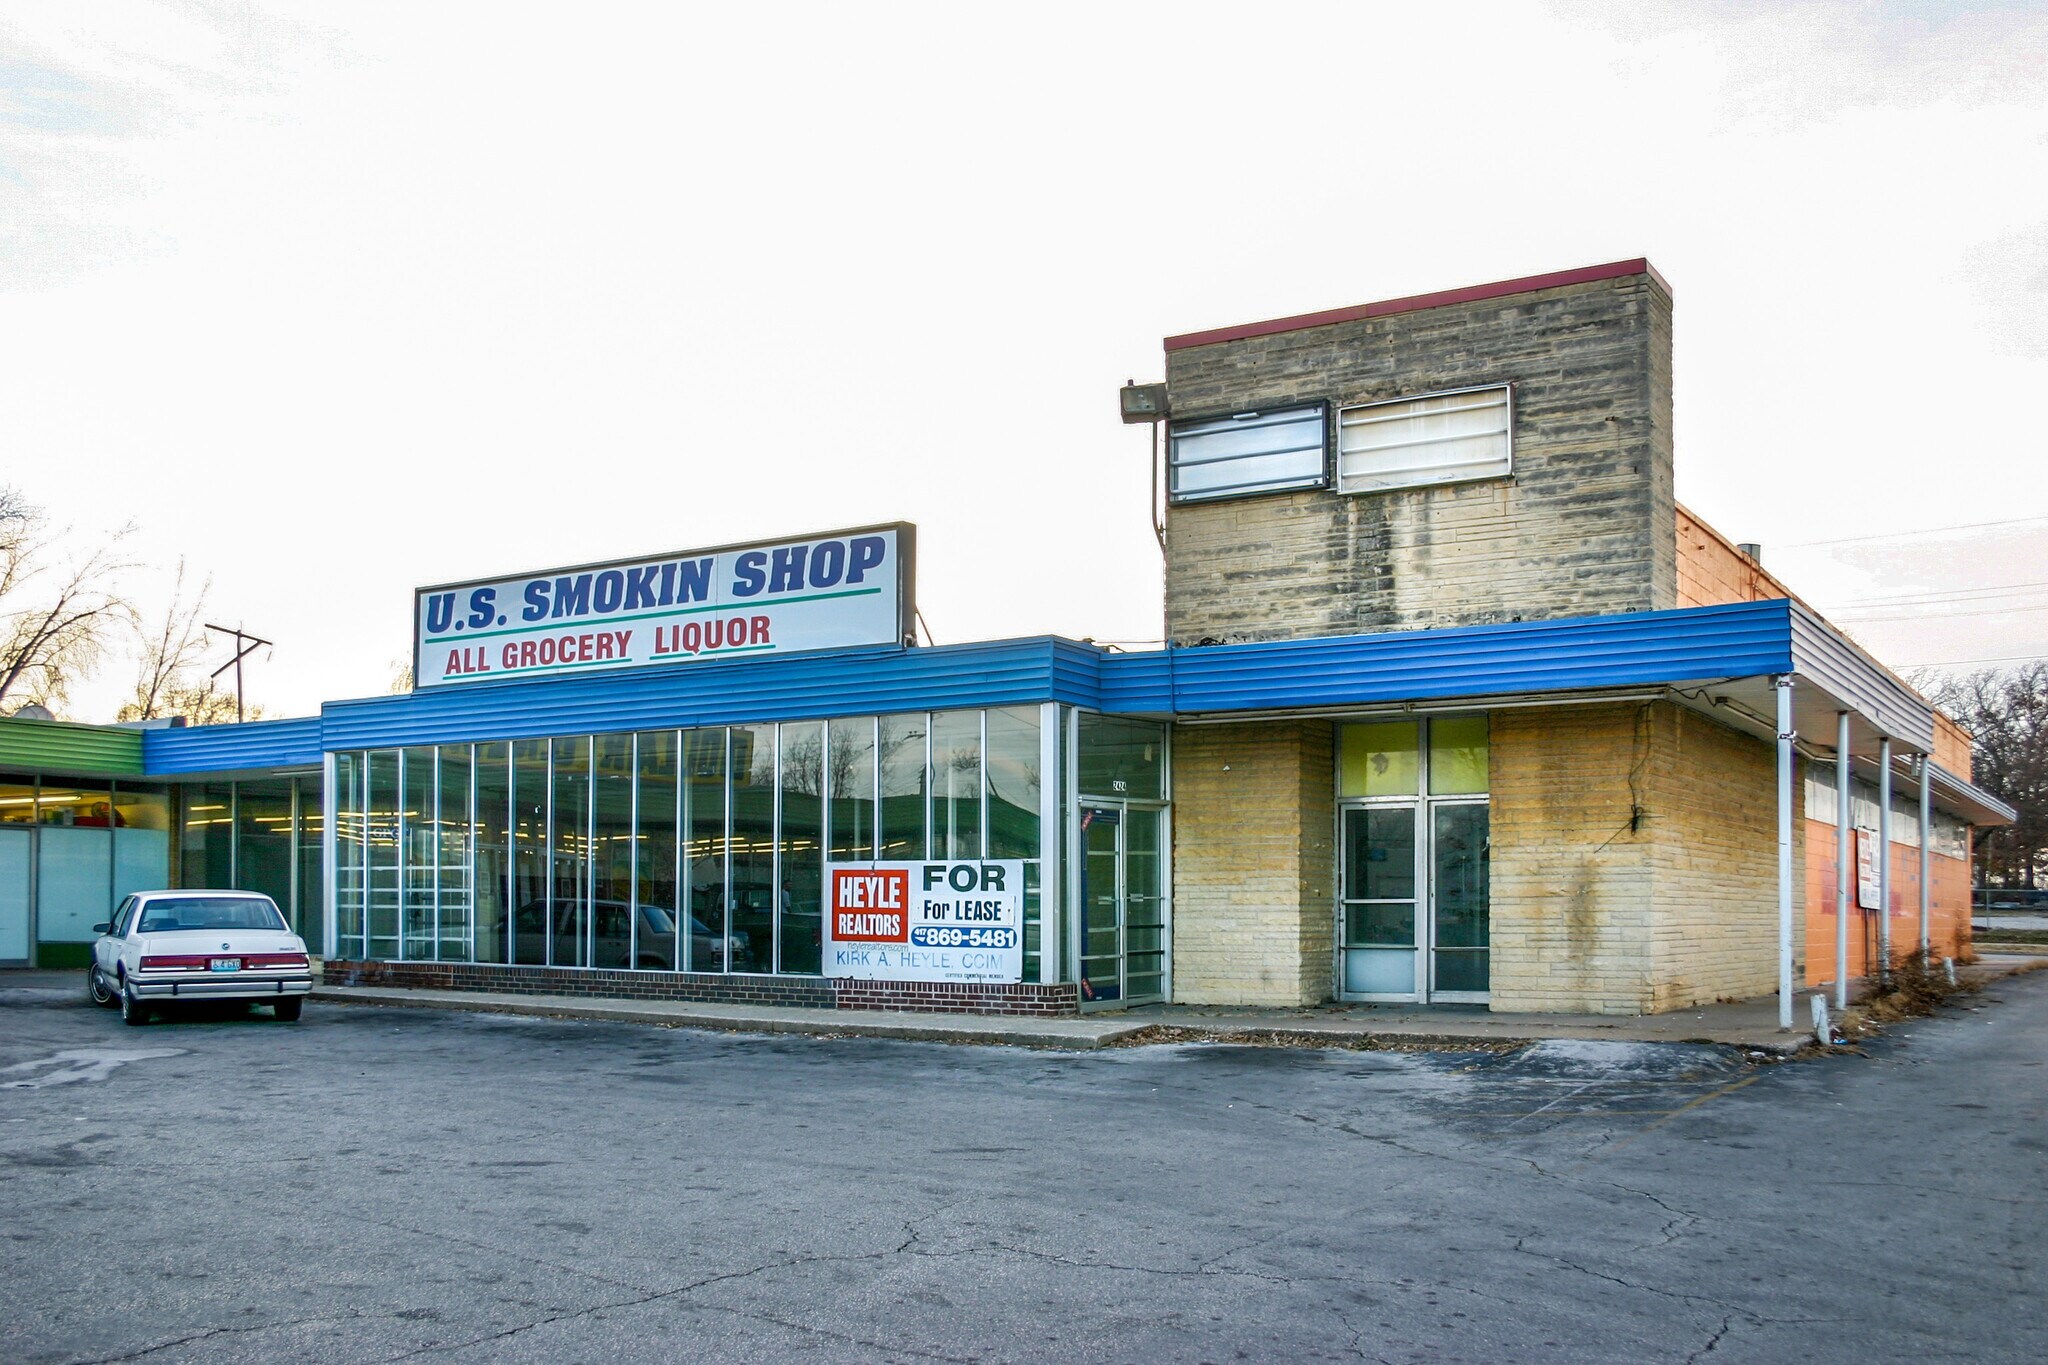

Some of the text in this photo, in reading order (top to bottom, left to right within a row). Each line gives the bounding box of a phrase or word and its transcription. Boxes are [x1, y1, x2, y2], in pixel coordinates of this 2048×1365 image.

[426, 536, 887, 634] U.S. SMOKIN SHOP
[445, 615, 771, 675] ALL GROCERY LIQUOR
[1112, 780, 1126, 792] 2424
[922, 864, 1007, 893] FOR
[838, 876, 901, 909] HEYLE
[923, 899, 1002, 922] For LEASE
[837, 913, 901, 937] REALTORS
[926, 927, 1015, 948] 869-5481
[836, 950, 871, 966] KIRK
[877, 951, 892, 967] A.
[961, 952, 1004, 970] CCIM
